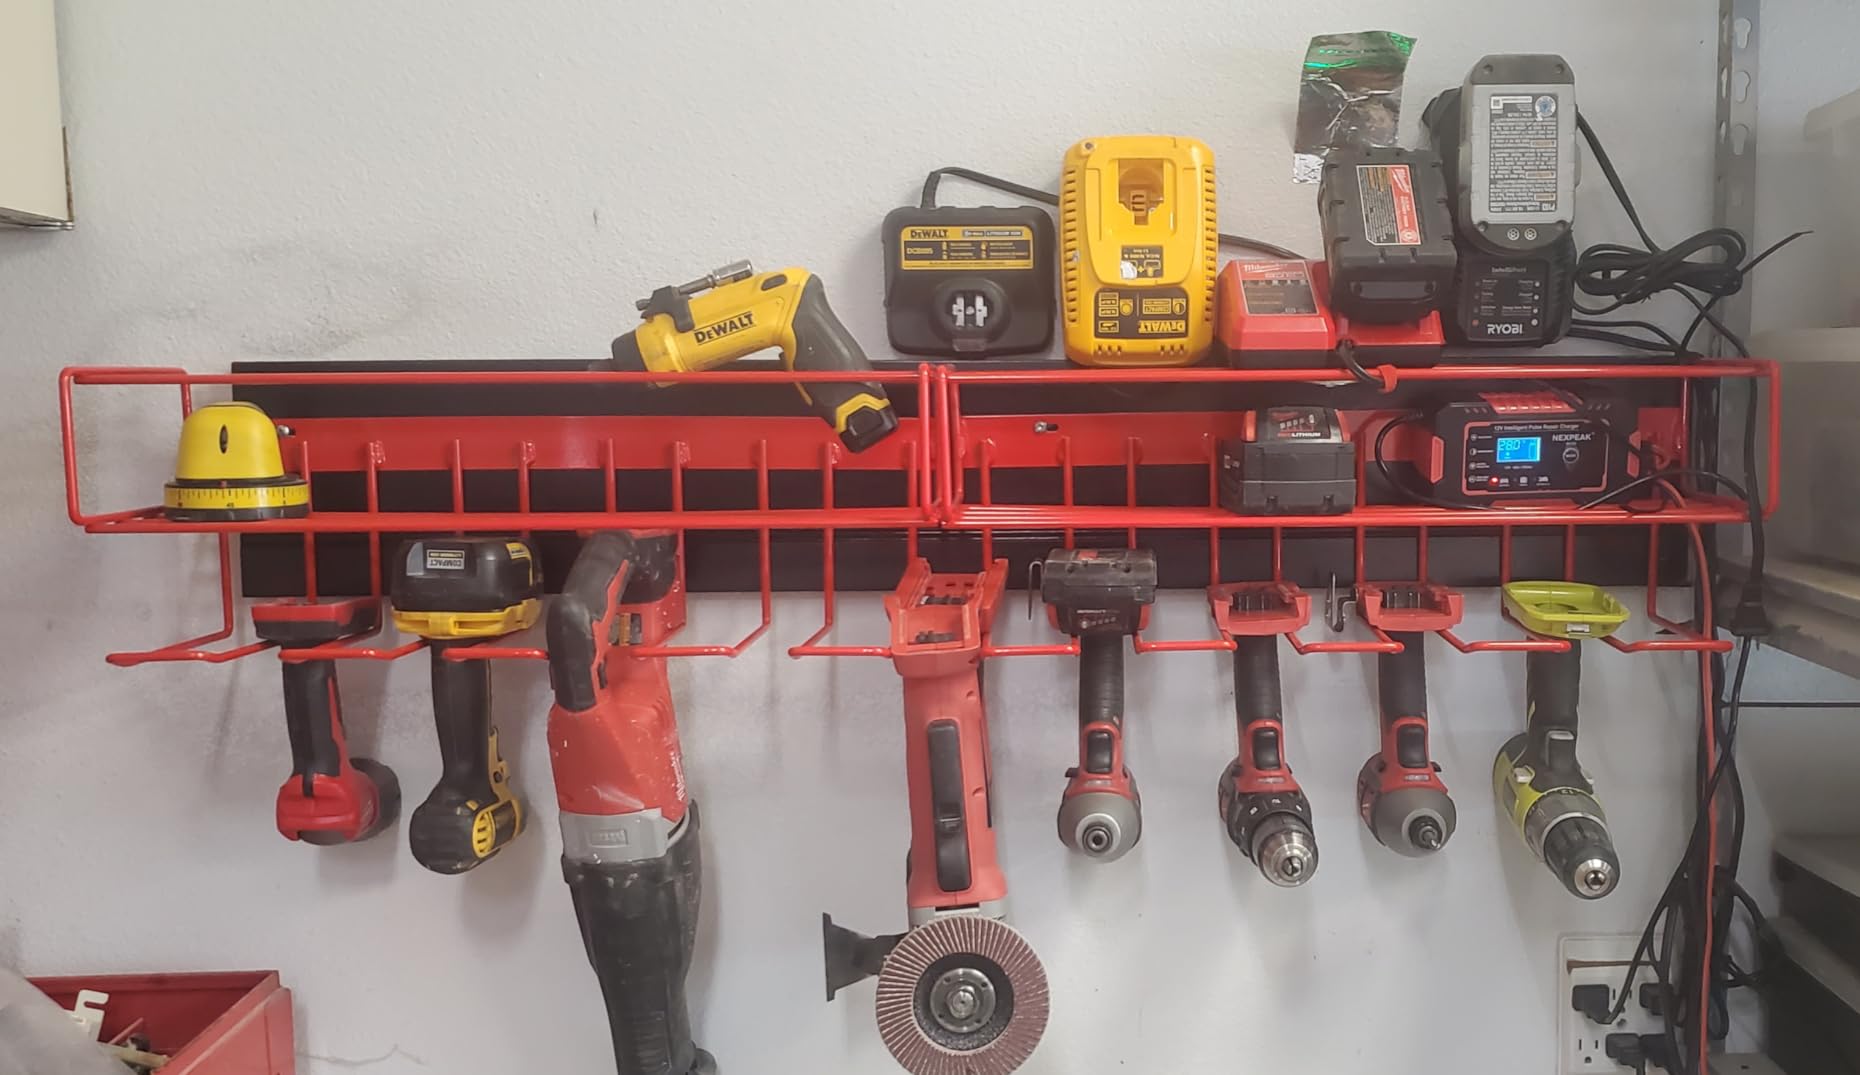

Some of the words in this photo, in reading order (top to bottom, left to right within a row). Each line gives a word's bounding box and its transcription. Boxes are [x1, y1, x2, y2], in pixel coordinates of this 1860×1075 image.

[694, 313, 753, 343] DEWALT
[1486, 323, 1523, 335] RYOBI
[1552, 433, 1592, 442] NEXPEAK
